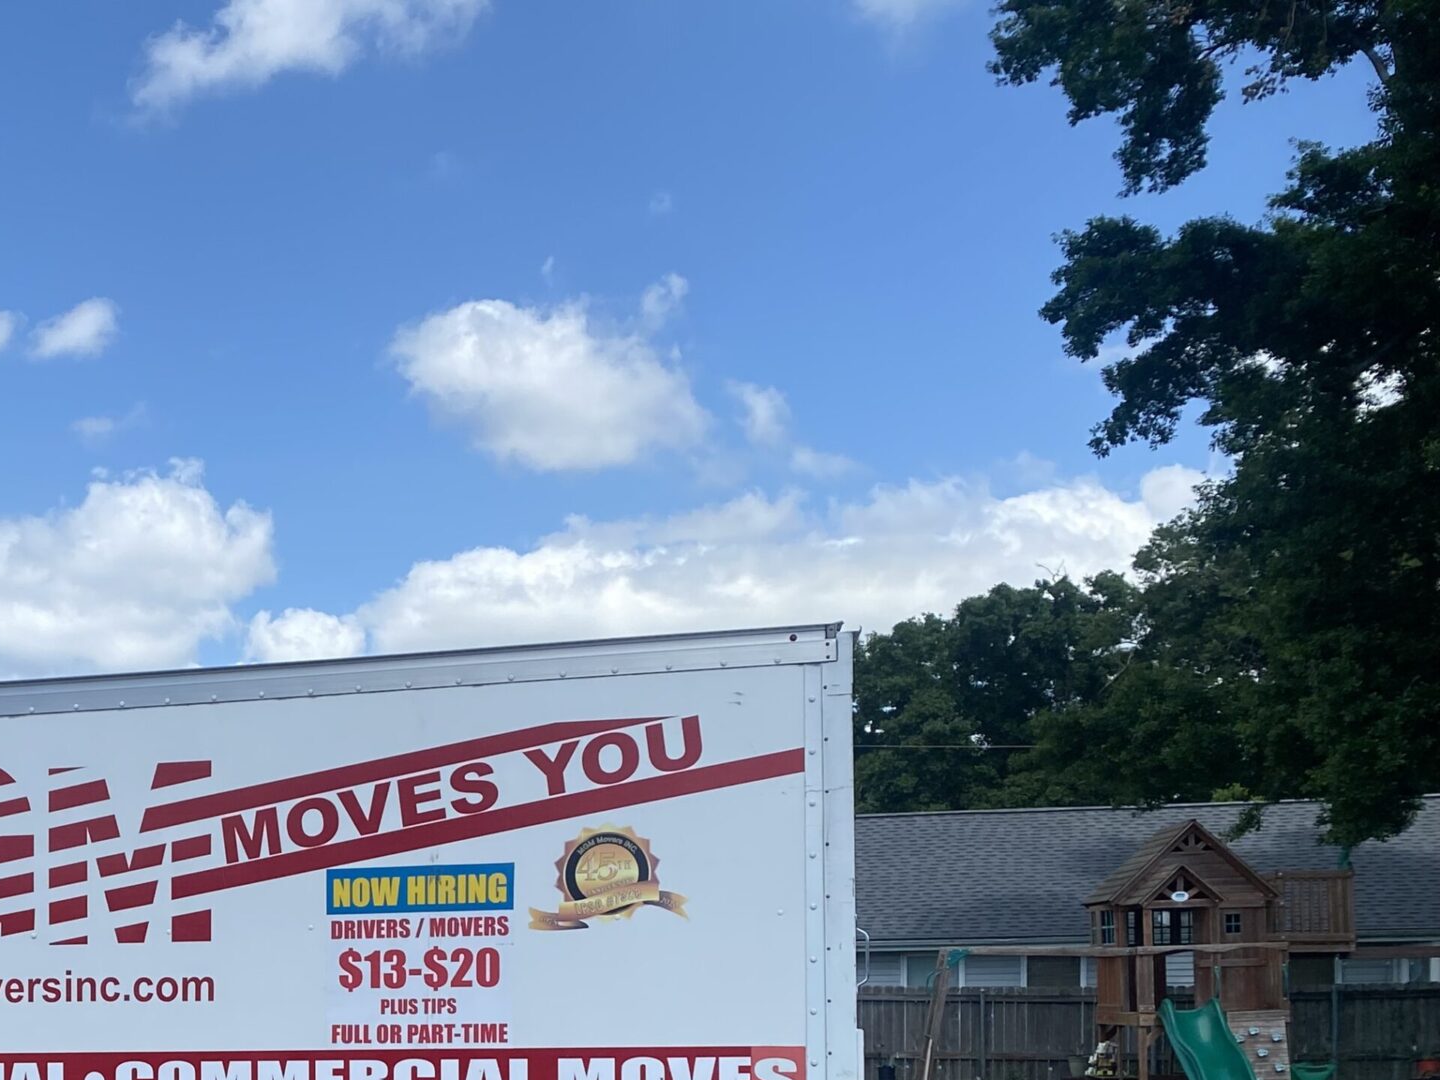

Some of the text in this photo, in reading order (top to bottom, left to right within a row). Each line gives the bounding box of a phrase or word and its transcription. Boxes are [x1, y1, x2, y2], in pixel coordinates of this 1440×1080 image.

[221, 715, 703, 864] MOVES YOU
[332, 872, 508, 908] NOW HIRING
[331, 918, 410, 940] DRIVERS
[429, 916, 509, 938] MOVERS
[338, 946, 500, 992] $13-$20
[380, 998, 457, 1015] PLUS TIPS
[331, 1023, 508, 1044] FULL OR PART-TIME
